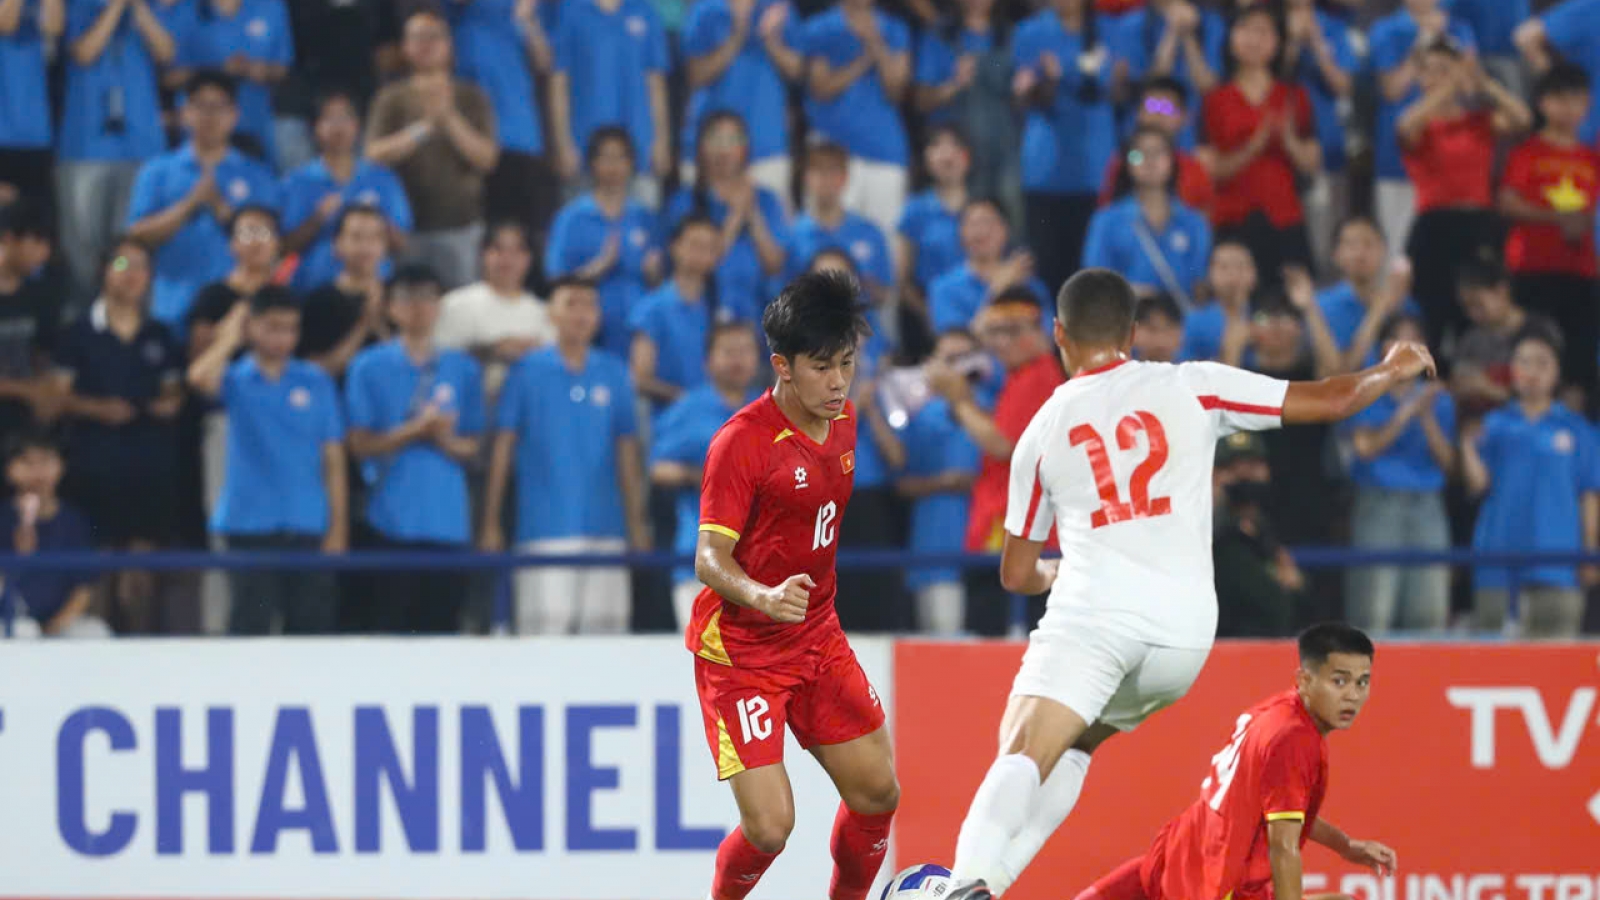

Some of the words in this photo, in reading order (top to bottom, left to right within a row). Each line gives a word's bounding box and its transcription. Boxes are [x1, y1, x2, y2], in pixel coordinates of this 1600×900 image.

[1068, 410, 1172, 529] 12
[812, 500, 837, 551] 12
[736, 695, 773, 745] 12
[55, 704, 728, 857] CHANNEL
